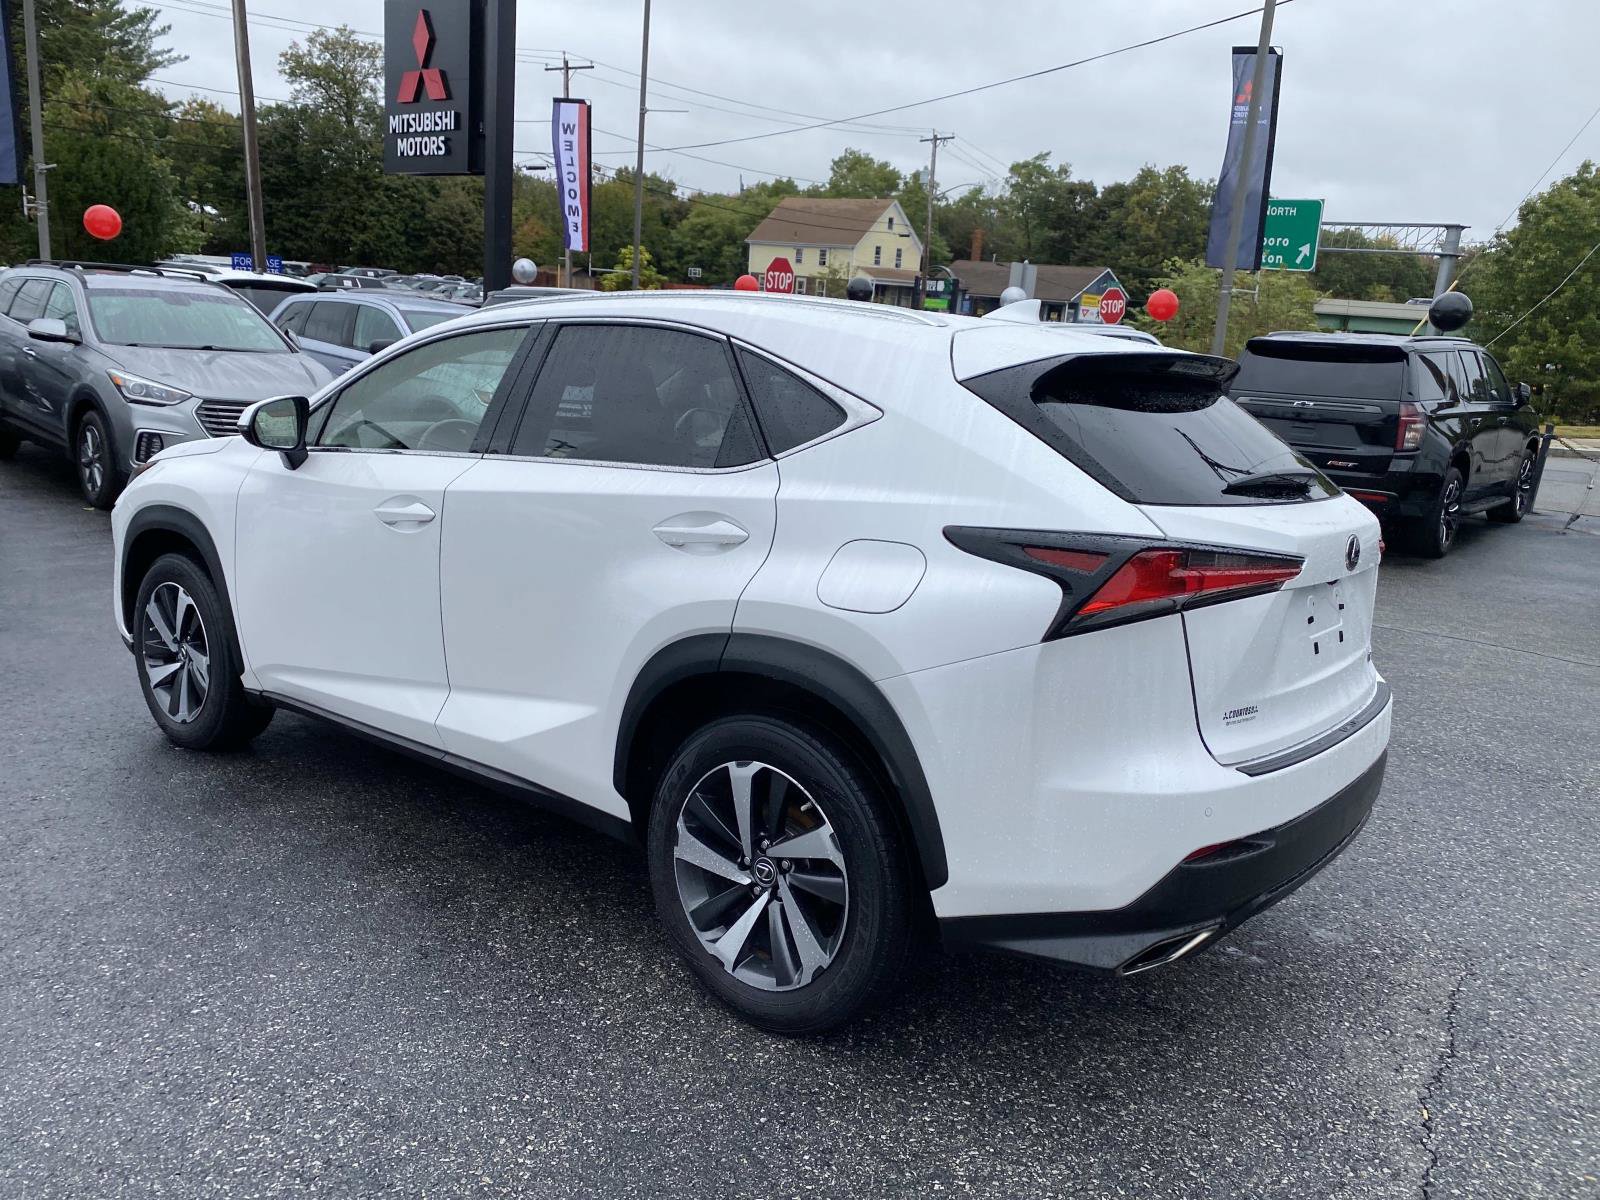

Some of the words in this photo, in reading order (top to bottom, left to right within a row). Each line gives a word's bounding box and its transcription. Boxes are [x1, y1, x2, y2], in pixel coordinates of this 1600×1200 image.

[389, 110, 455, 134] MITSUBISHI
[397, 136, 446, 157] MOTORS
[234, 256, 252, 266] FOR
[767, 271, 792, 290] STOP
[1101, 300, 1123, 314] STOP
